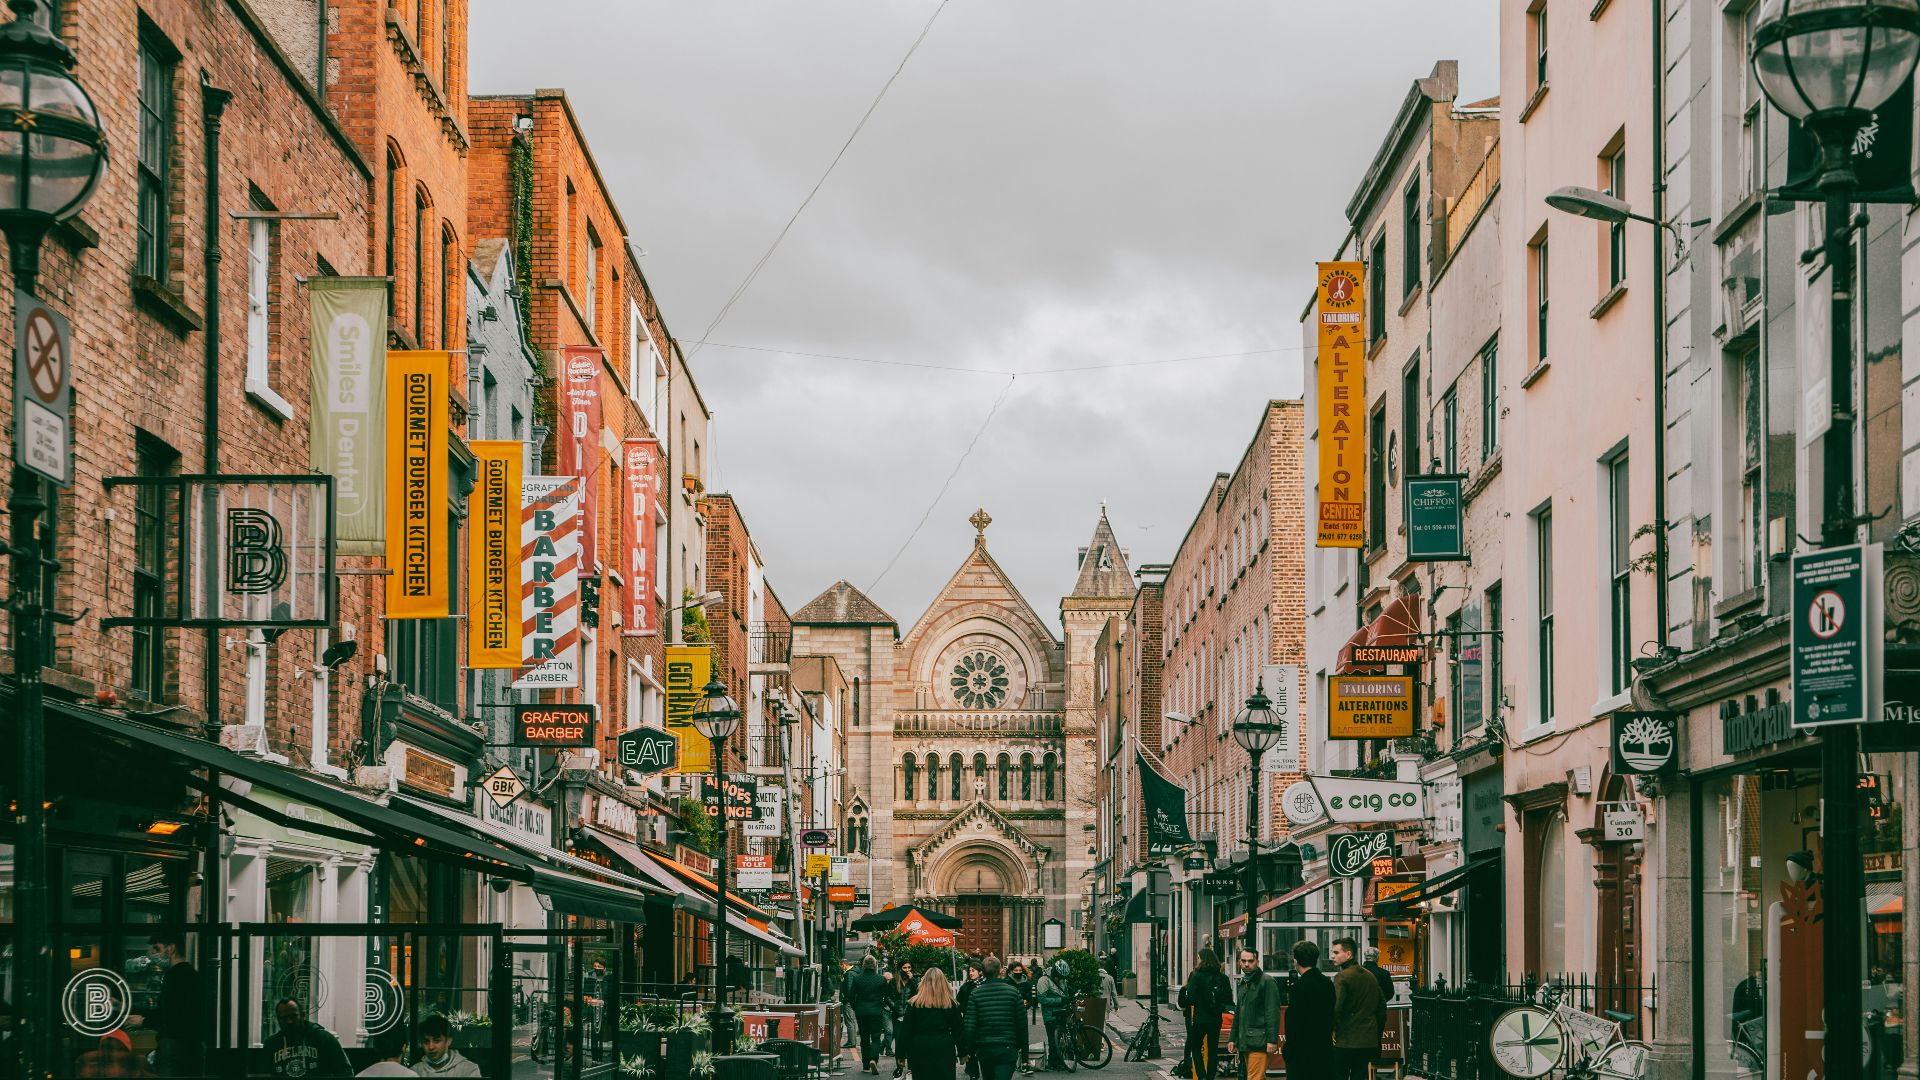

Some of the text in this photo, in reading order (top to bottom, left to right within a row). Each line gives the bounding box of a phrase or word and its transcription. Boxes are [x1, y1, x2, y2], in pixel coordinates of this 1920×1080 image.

[1322, 269, 1360, 288] ALTERATION
[1326, 297, 1355, 308] CENTRE
[1322, 313, 1360, 323] TAILORING
[338, 324, 361, 500] Smiles Dental
[1332, 334, 1351, 501] ALTERATION
[409, 373, 426, 597] GOURMET BURGER KITCHEN
[526, 483, 574, 493] GRAFTON
[527, 495, 569, 504] BARBER
[1413, 497, 1455, 507] CHIFFON
[1323, 503, 1361, 520] CENTRE
[488, 459, 503, 649] GOURMET BURGER KITCHEN
[632, 491, 646, 630] DINER
[532, 509, 558, 660] BARBER
[1355, 648, 1418, 662] RESTAURANT
[534, 662, 573, 671] RAFTON
[526, 673, 569, 683] BARBER
[667, 661, 702, 729] GOTHAM
[1343, 684, 1401, 694] TAILORING
[1276, 686, 1288, 716] Clinic
[1338, 700, 1408, 711] ALTERATIONS
[522, 711, 589, 724] GRAFTON
[1353, 713, 1393, 724] CENTRE
[526, 727, 584, 739] BARBER
[622, 738, 674, 766] EAT
[729, 774, 756, 783] WINES
[492, 780, 515, 793] GBK
[1330, 792, 1417, 813] e cig co
[489, 799, 519, 828] GALLERY
[524, 808, 535, 834] NO.
[535, 812, 545, 836] SIX
[1359, 834, 1370, 842] LA
[1616, 827, 1633, 837] 30
[1331, 832, 1392, 876] Cave
[1374, 866, 1393, 876] BAR
[85, 983, 113, 1022] B
[749, 1023, 769, 1036] EAT
[274, 1045, 318, 1063] IRELAND
